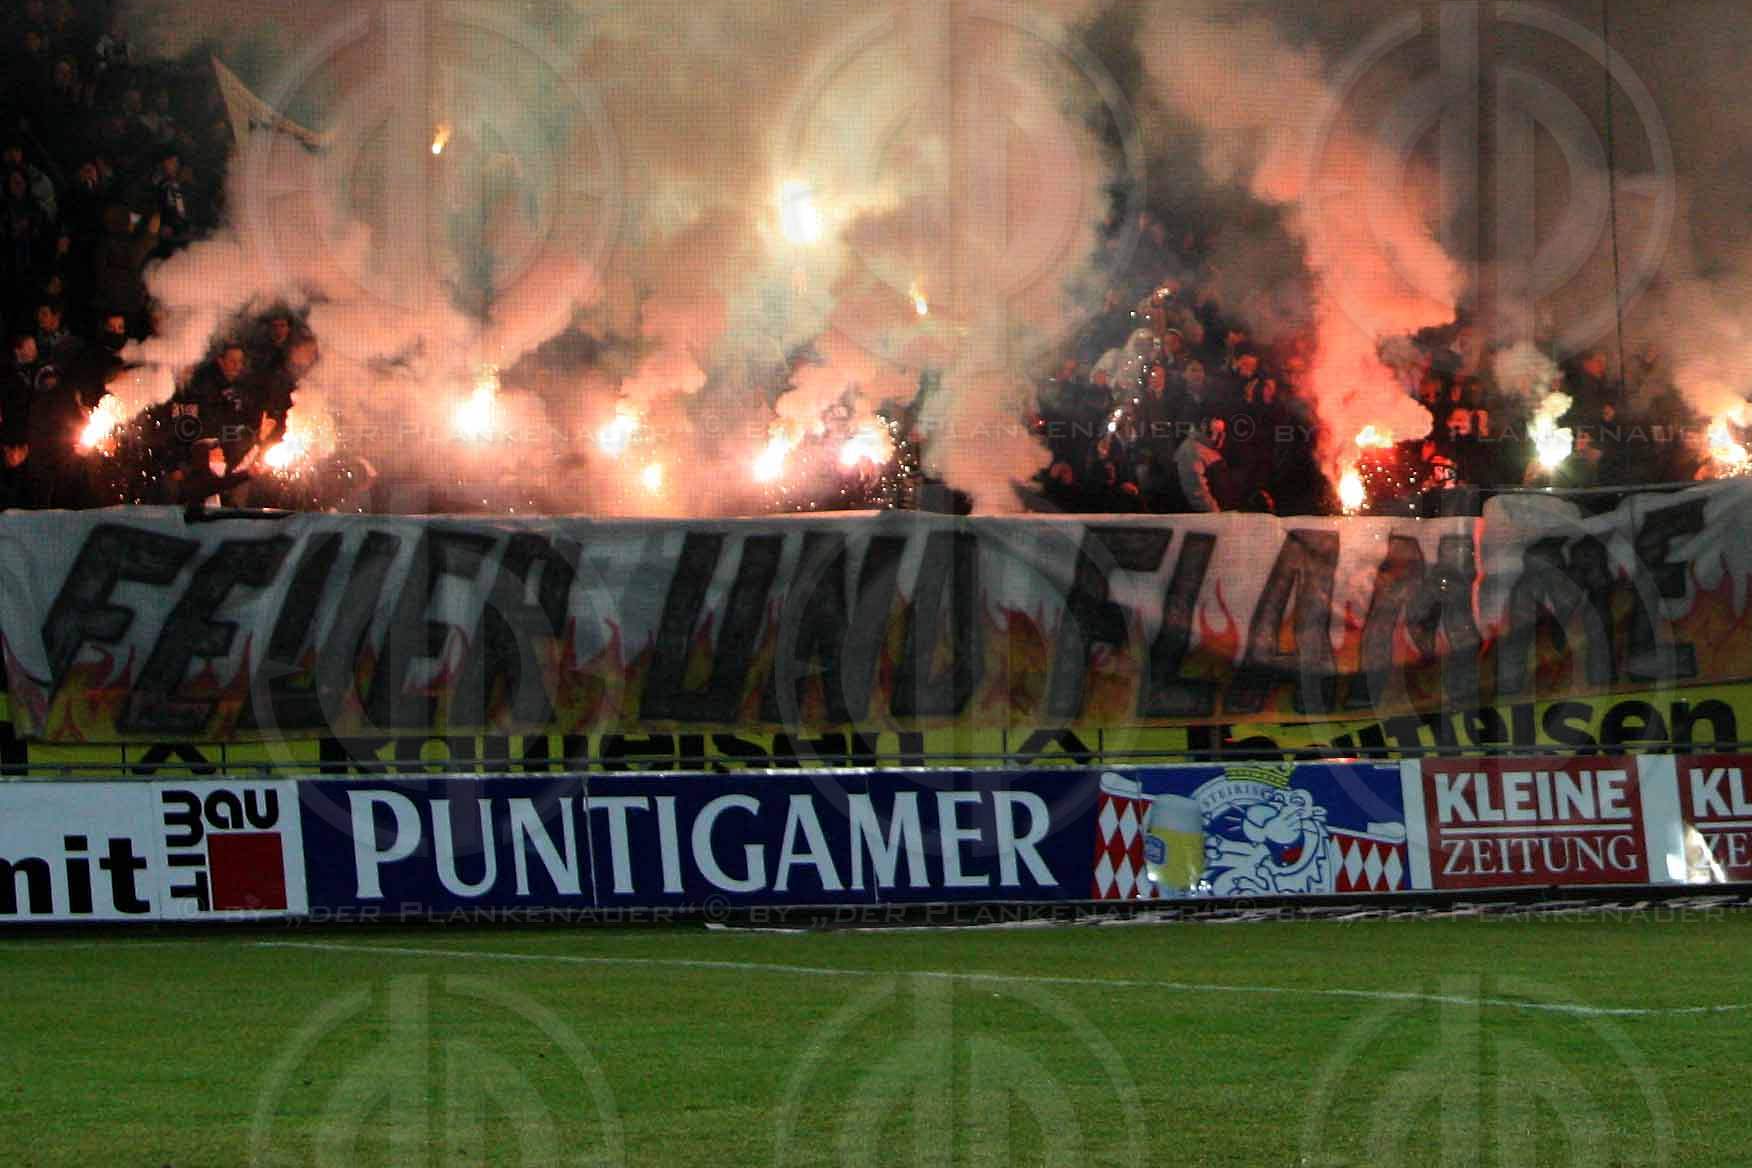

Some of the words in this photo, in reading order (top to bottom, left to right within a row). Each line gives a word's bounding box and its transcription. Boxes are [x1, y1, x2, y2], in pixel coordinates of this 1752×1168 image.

[40, 523, 583, 734] FEUER
[640, 530, 983, 718] UND
[1434, 770, 1632, 822] KLEINE
[348, 789, 1059, 899] PUNTIGAMER
[1441, 834, 1638, 875] ZEITUNG
